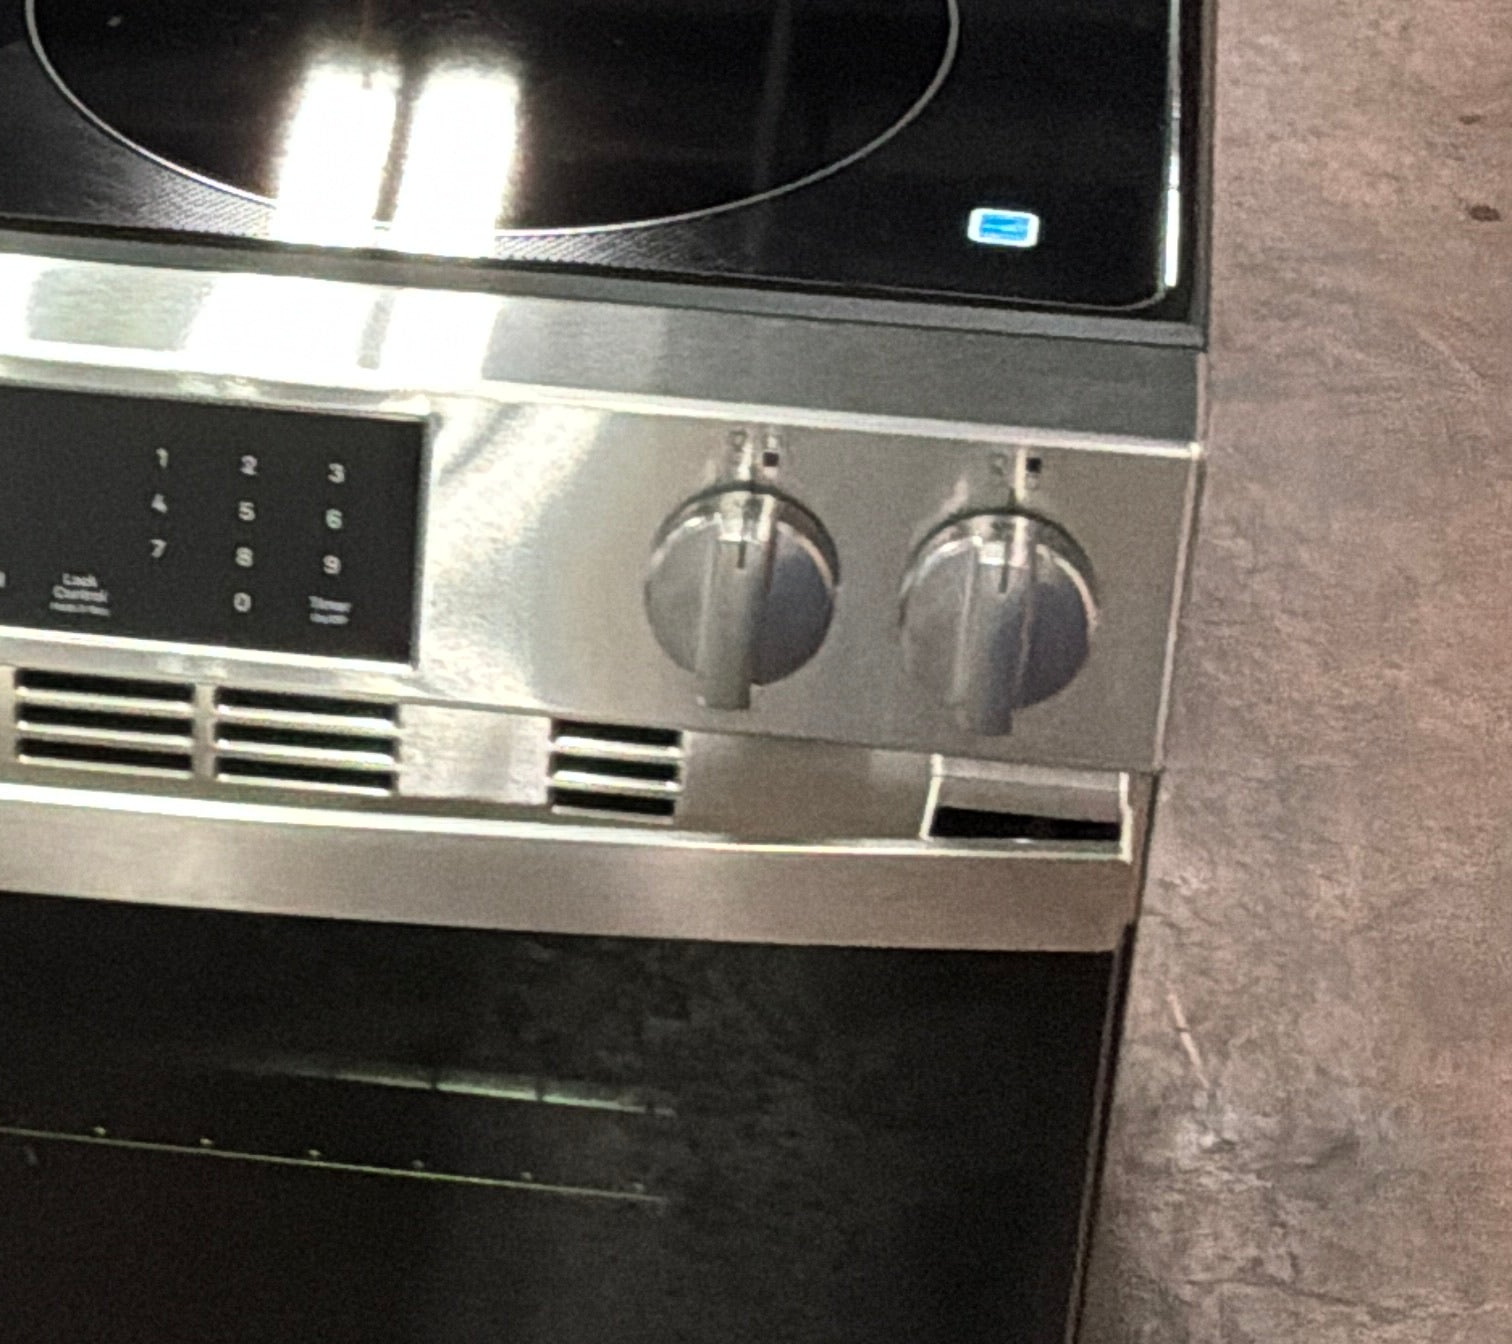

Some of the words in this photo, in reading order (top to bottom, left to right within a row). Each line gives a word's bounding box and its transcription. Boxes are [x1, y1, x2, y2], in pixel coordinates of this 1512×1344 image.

[156, 447, 169, 467] 1
[241, 455, 259, 476] 2
[328, 463, 345, 484] 3
[151, 493, 168, 514] 4
[238, 501, 256, 521] 5
[325, 508, 343, 529] 6
[150, 538, 167, 558] 7
[235, 547, 253, 568] 8
[323, 555, 341, 575] 9
[233, 592, 252, 613] 0
